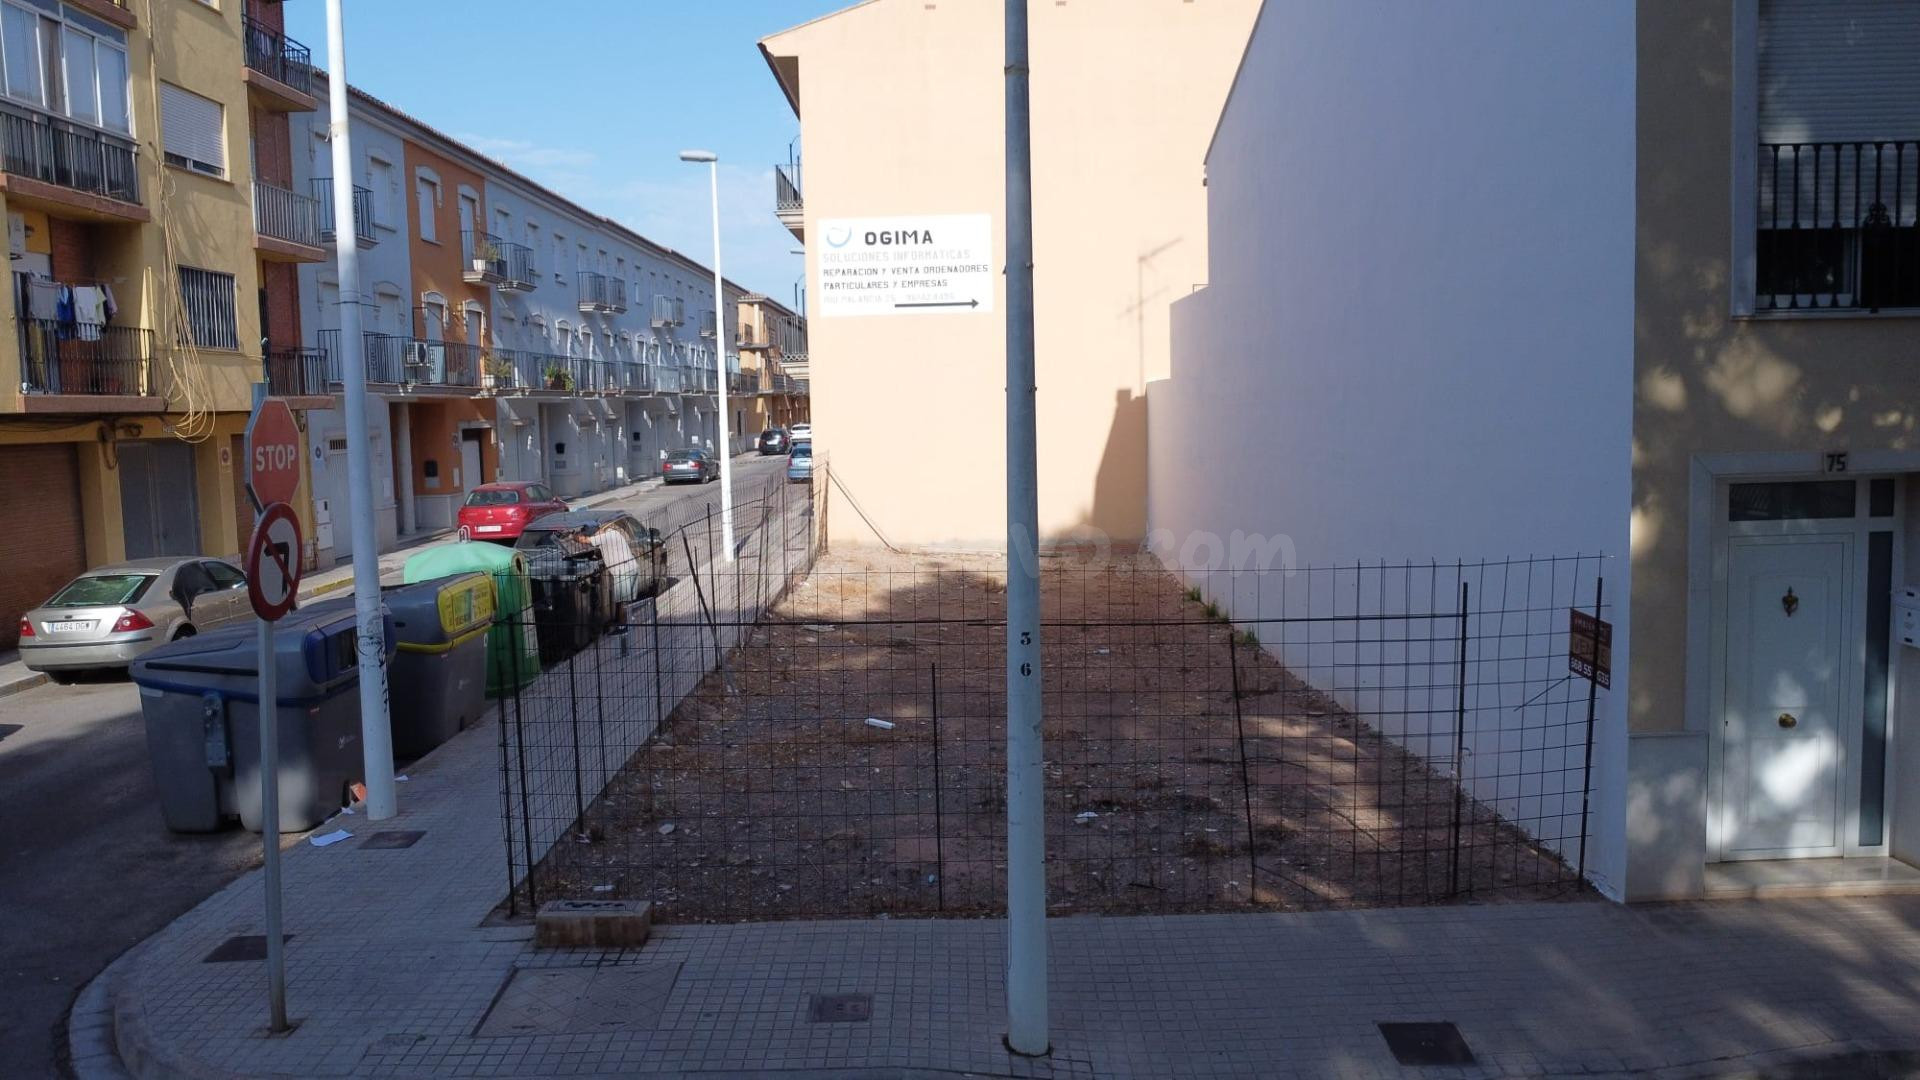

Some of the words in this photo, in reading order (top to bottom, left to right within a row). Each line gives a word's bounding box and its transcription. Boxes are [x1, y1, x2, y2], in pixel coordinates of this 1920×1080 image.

[864, 230, 933, 245] OGIMA
[823, 251, 889, 263] SOLUCIONES
[893, 249, 971, 261] INFORMATICAS
[823, 268, 878, 277] REPARACION
[882, 268, 887, 276] Y
[891, 266, 920, 275] VENTA
[923, 264, 989, 274] ORDENADORES
[824, 281, 889, 290] PARTICULARES
[901, 279, 948, 288] EMPRESAS
[256, 444, 296, 472] STOP
[1826, 454, 1847, 472] 75
[1020, 663, 1032, 677] 6
